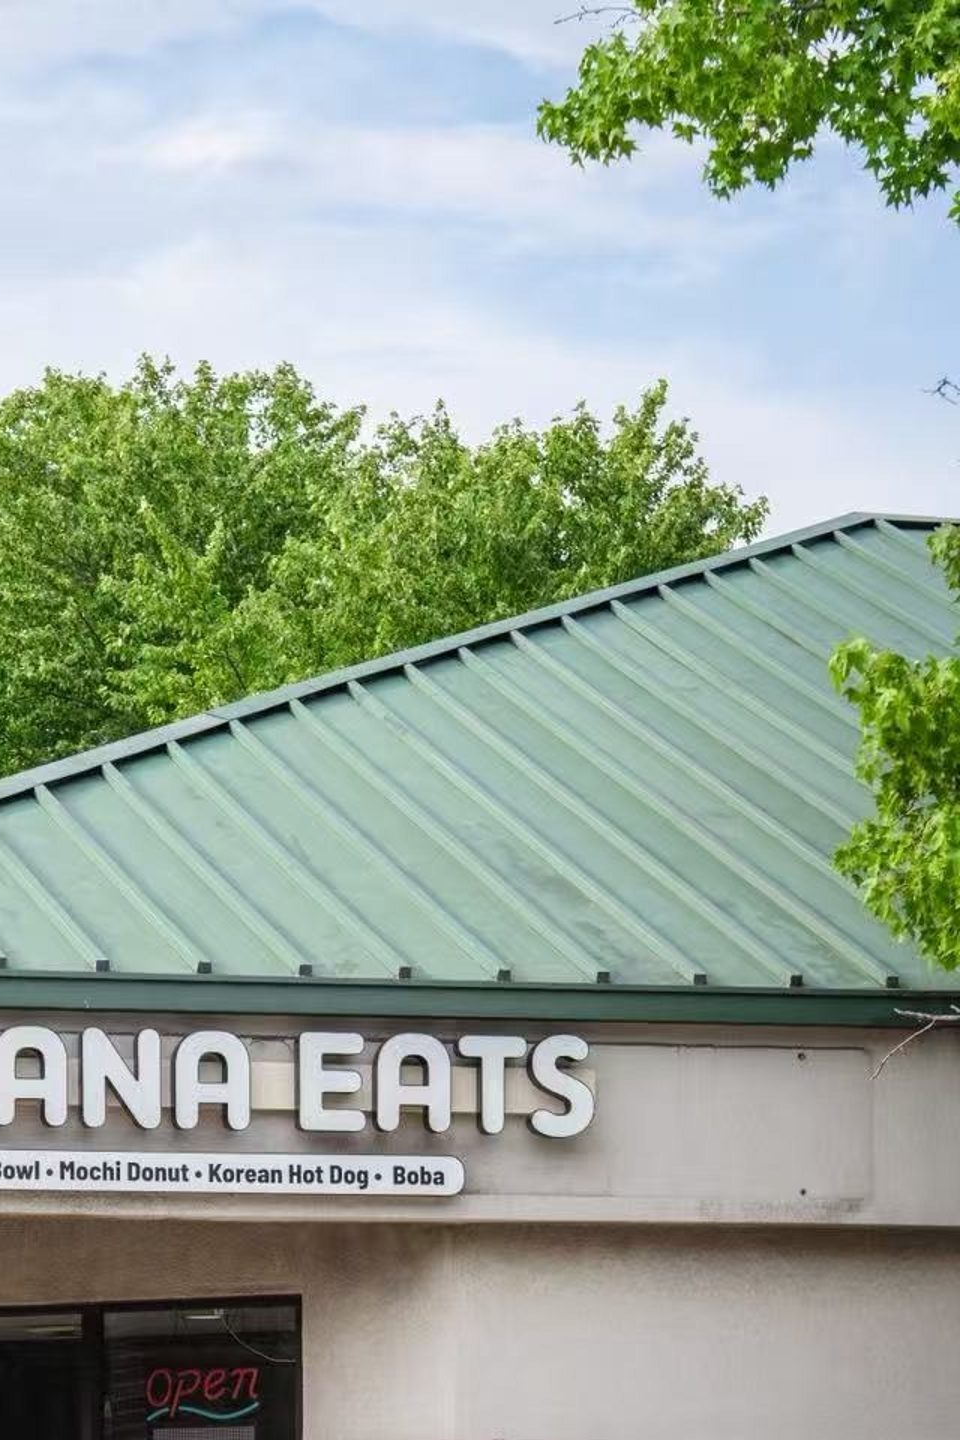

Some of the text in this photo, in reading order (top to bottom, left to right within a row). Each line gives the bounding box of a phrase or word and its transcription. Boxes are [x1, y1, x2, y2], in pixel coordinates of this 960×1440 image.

[298, 1031, 596, 1138] EATS
[59, 1160, 121, 1181] Mochi
[127, 1161, 189, 1183] Donut
[208, 1163, 283, 1184] Korean
[289, 1164, 323, 1185] Hot
[330, 1165, 369, 1189] Dog
[393, 1166, 445, 1186] Boba
